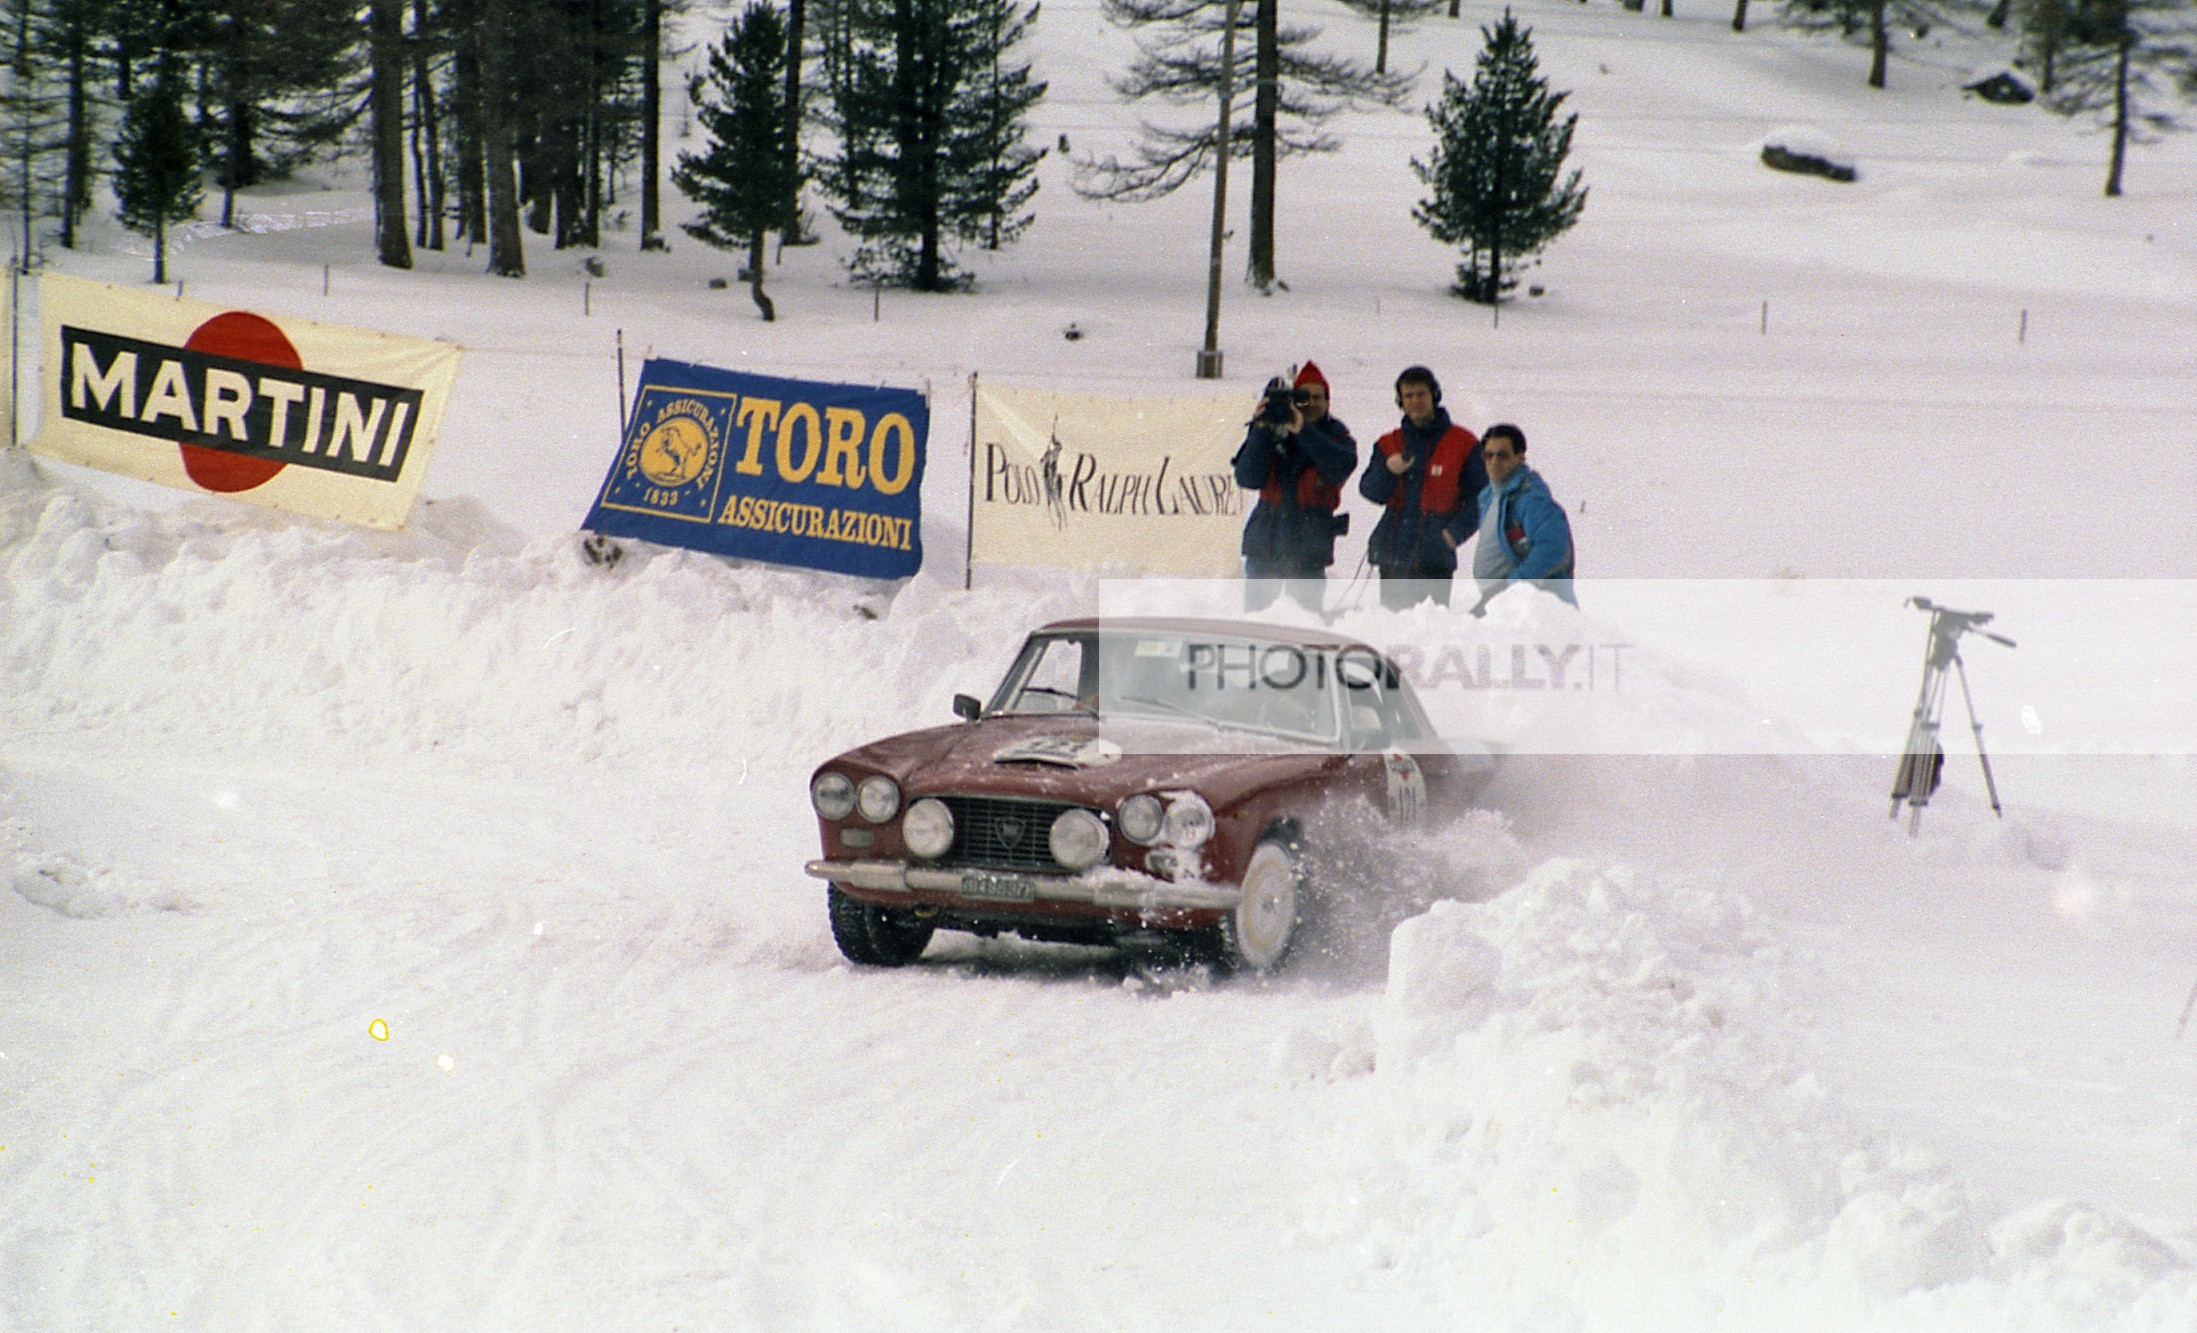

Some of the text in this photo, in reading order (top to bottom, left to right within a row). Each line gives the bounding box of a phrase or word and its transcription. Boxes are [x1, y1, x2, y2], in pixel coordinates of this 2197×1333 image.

[71, 342, 409, 467] MARTINI
[625, 399, 719, 490] TORO ASSICURAZIONI
[736, 397, 916, 495] TORO
[643, 487, 679, 507] 1833
[717, 496, 913, 550] ASSICURAZIONI
